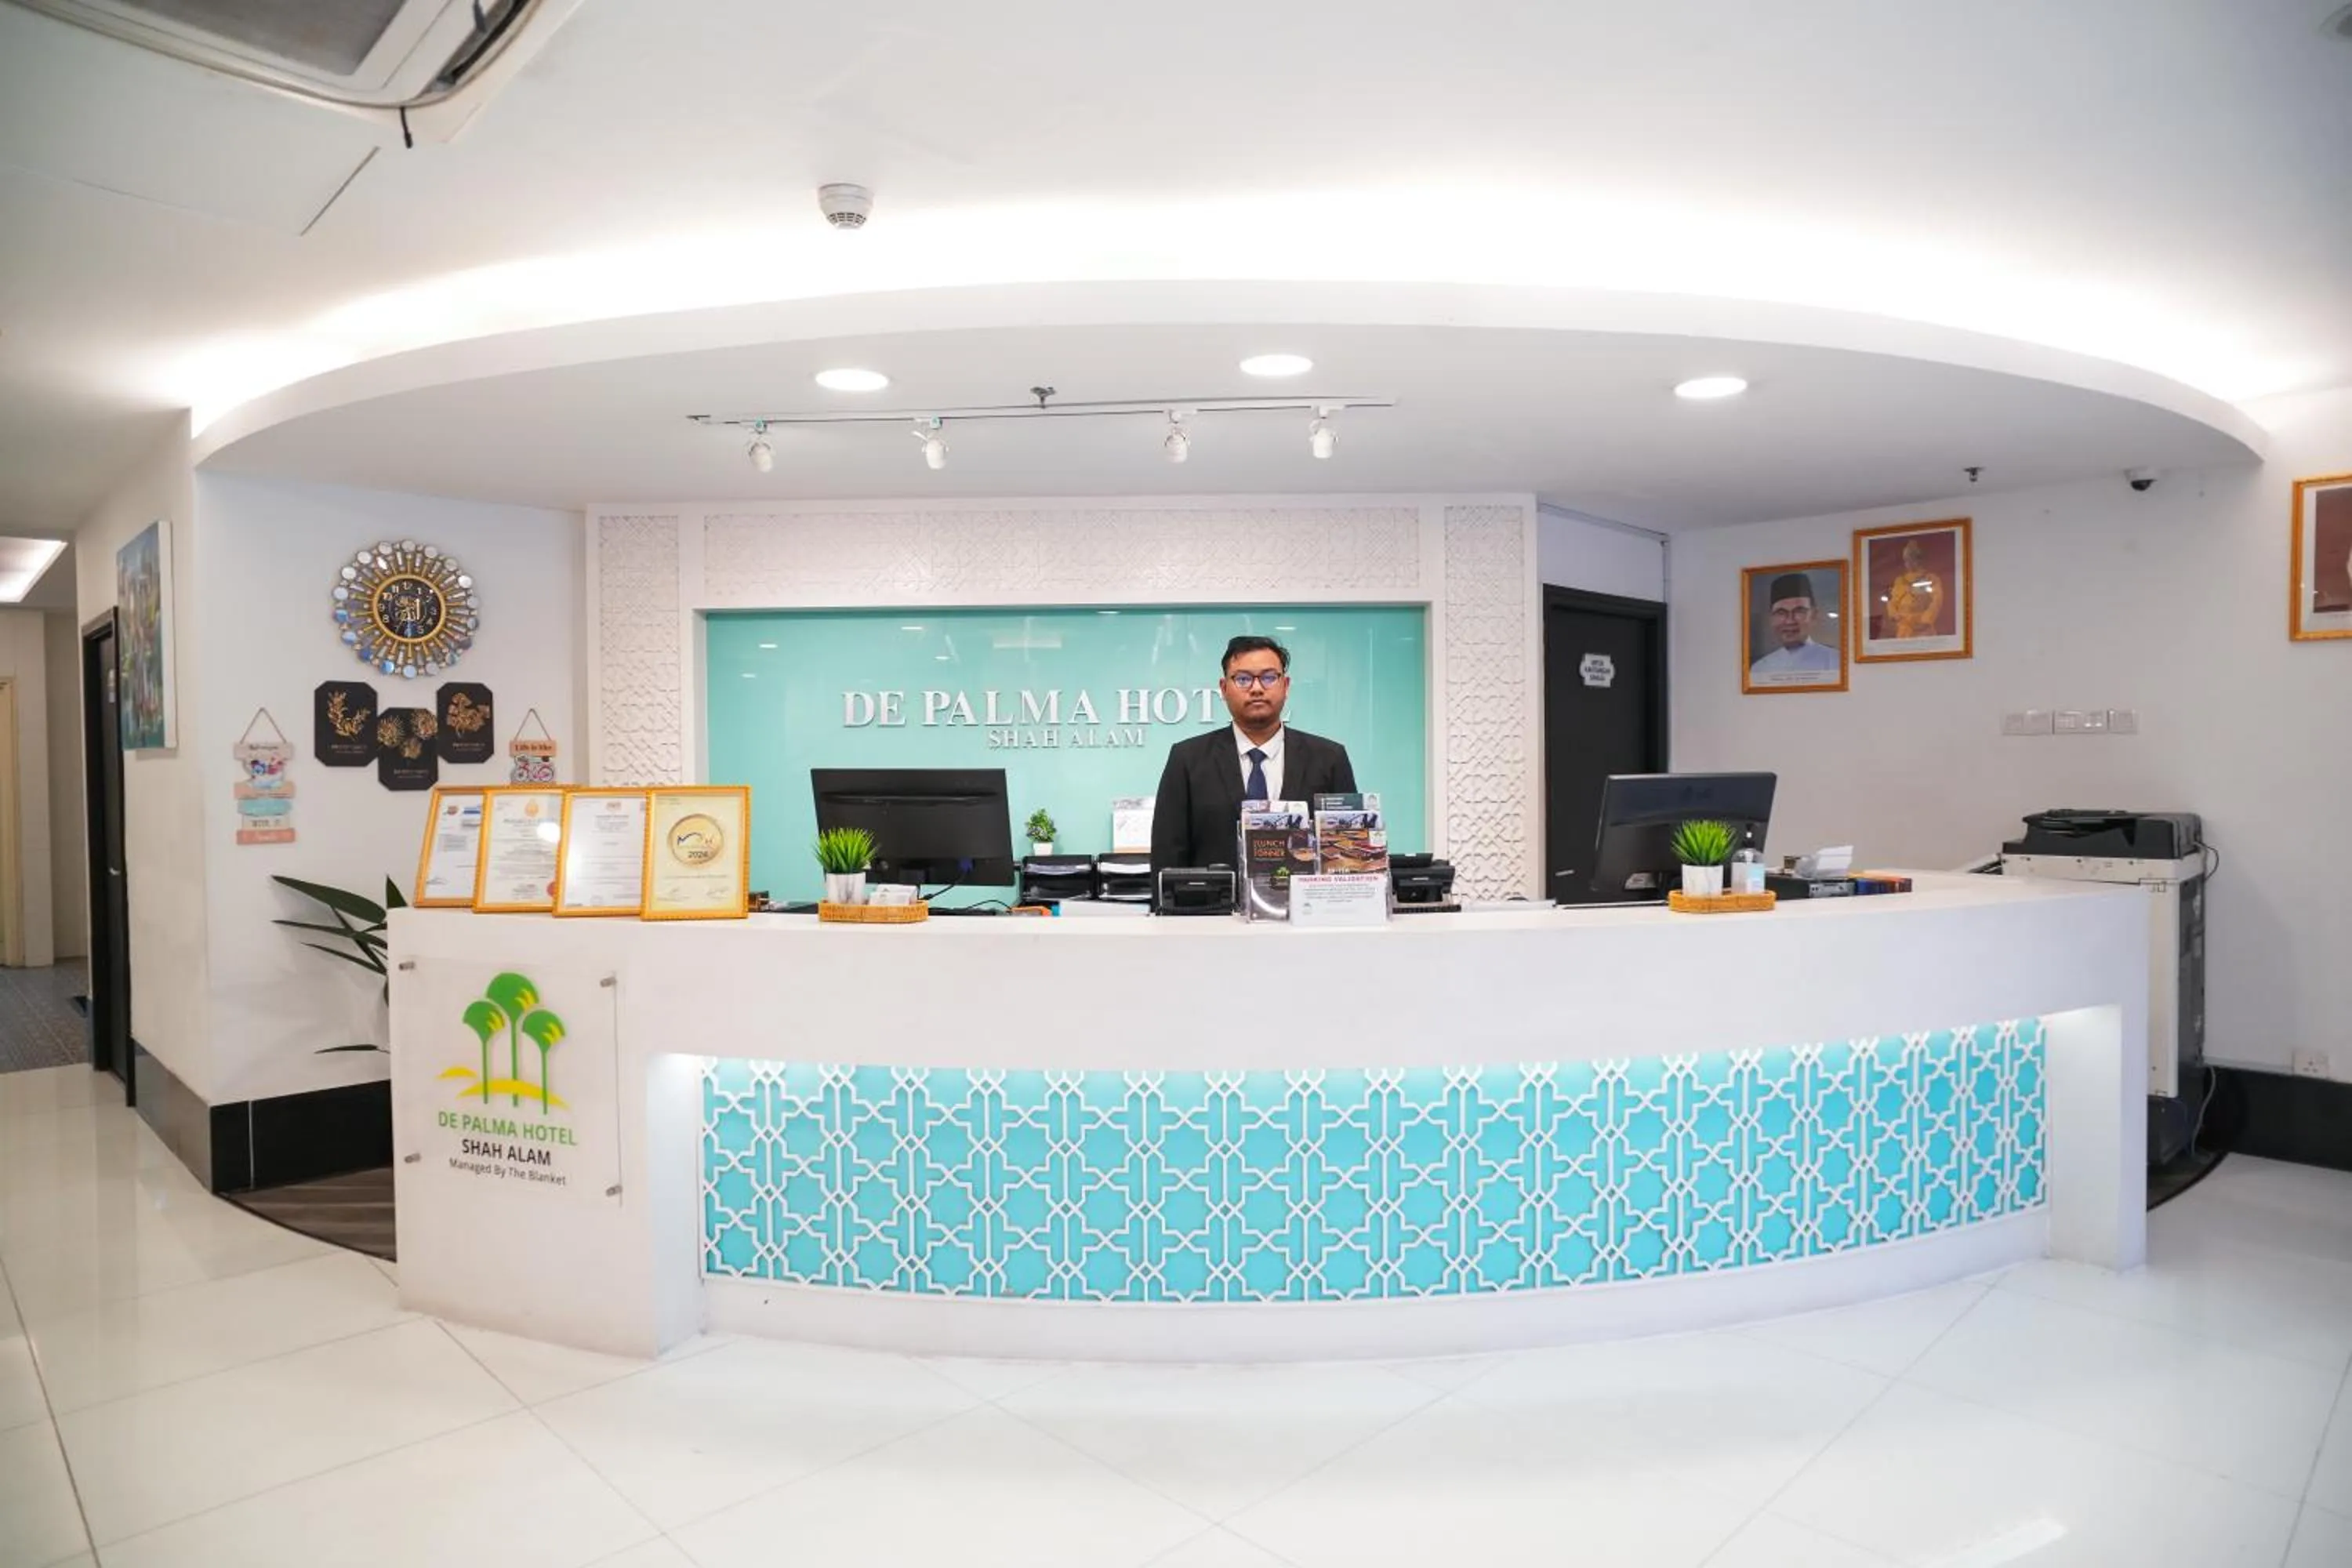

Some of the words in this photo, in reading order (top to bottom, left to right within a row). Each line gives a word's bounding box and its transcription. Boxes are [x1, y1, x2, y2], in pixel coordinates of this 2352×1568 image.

[842, 690, 906, 728] DE
[921, 689, 1101, 727] PALMA
[1116, 688, 1290, 724] HOT
[988, 729, 1060, 750] SHAH
[1068, 728, 1145, 748] ALAM
[438, 1111, 458, 1129] DE
[462, 1114, 518, 1137] PALMA
[523, 1123, 577, 1145] HOTEL
[462, 1138, 503, 1159] SHAH
[507, 1145, 552, 1166] ALAM
[449, 1157, 492, 1175] Managed
[494, 1163, 506, 1178] By
[509, 1167, 526, 1180] The
[528, 1171, 566, 1186] Blanket
